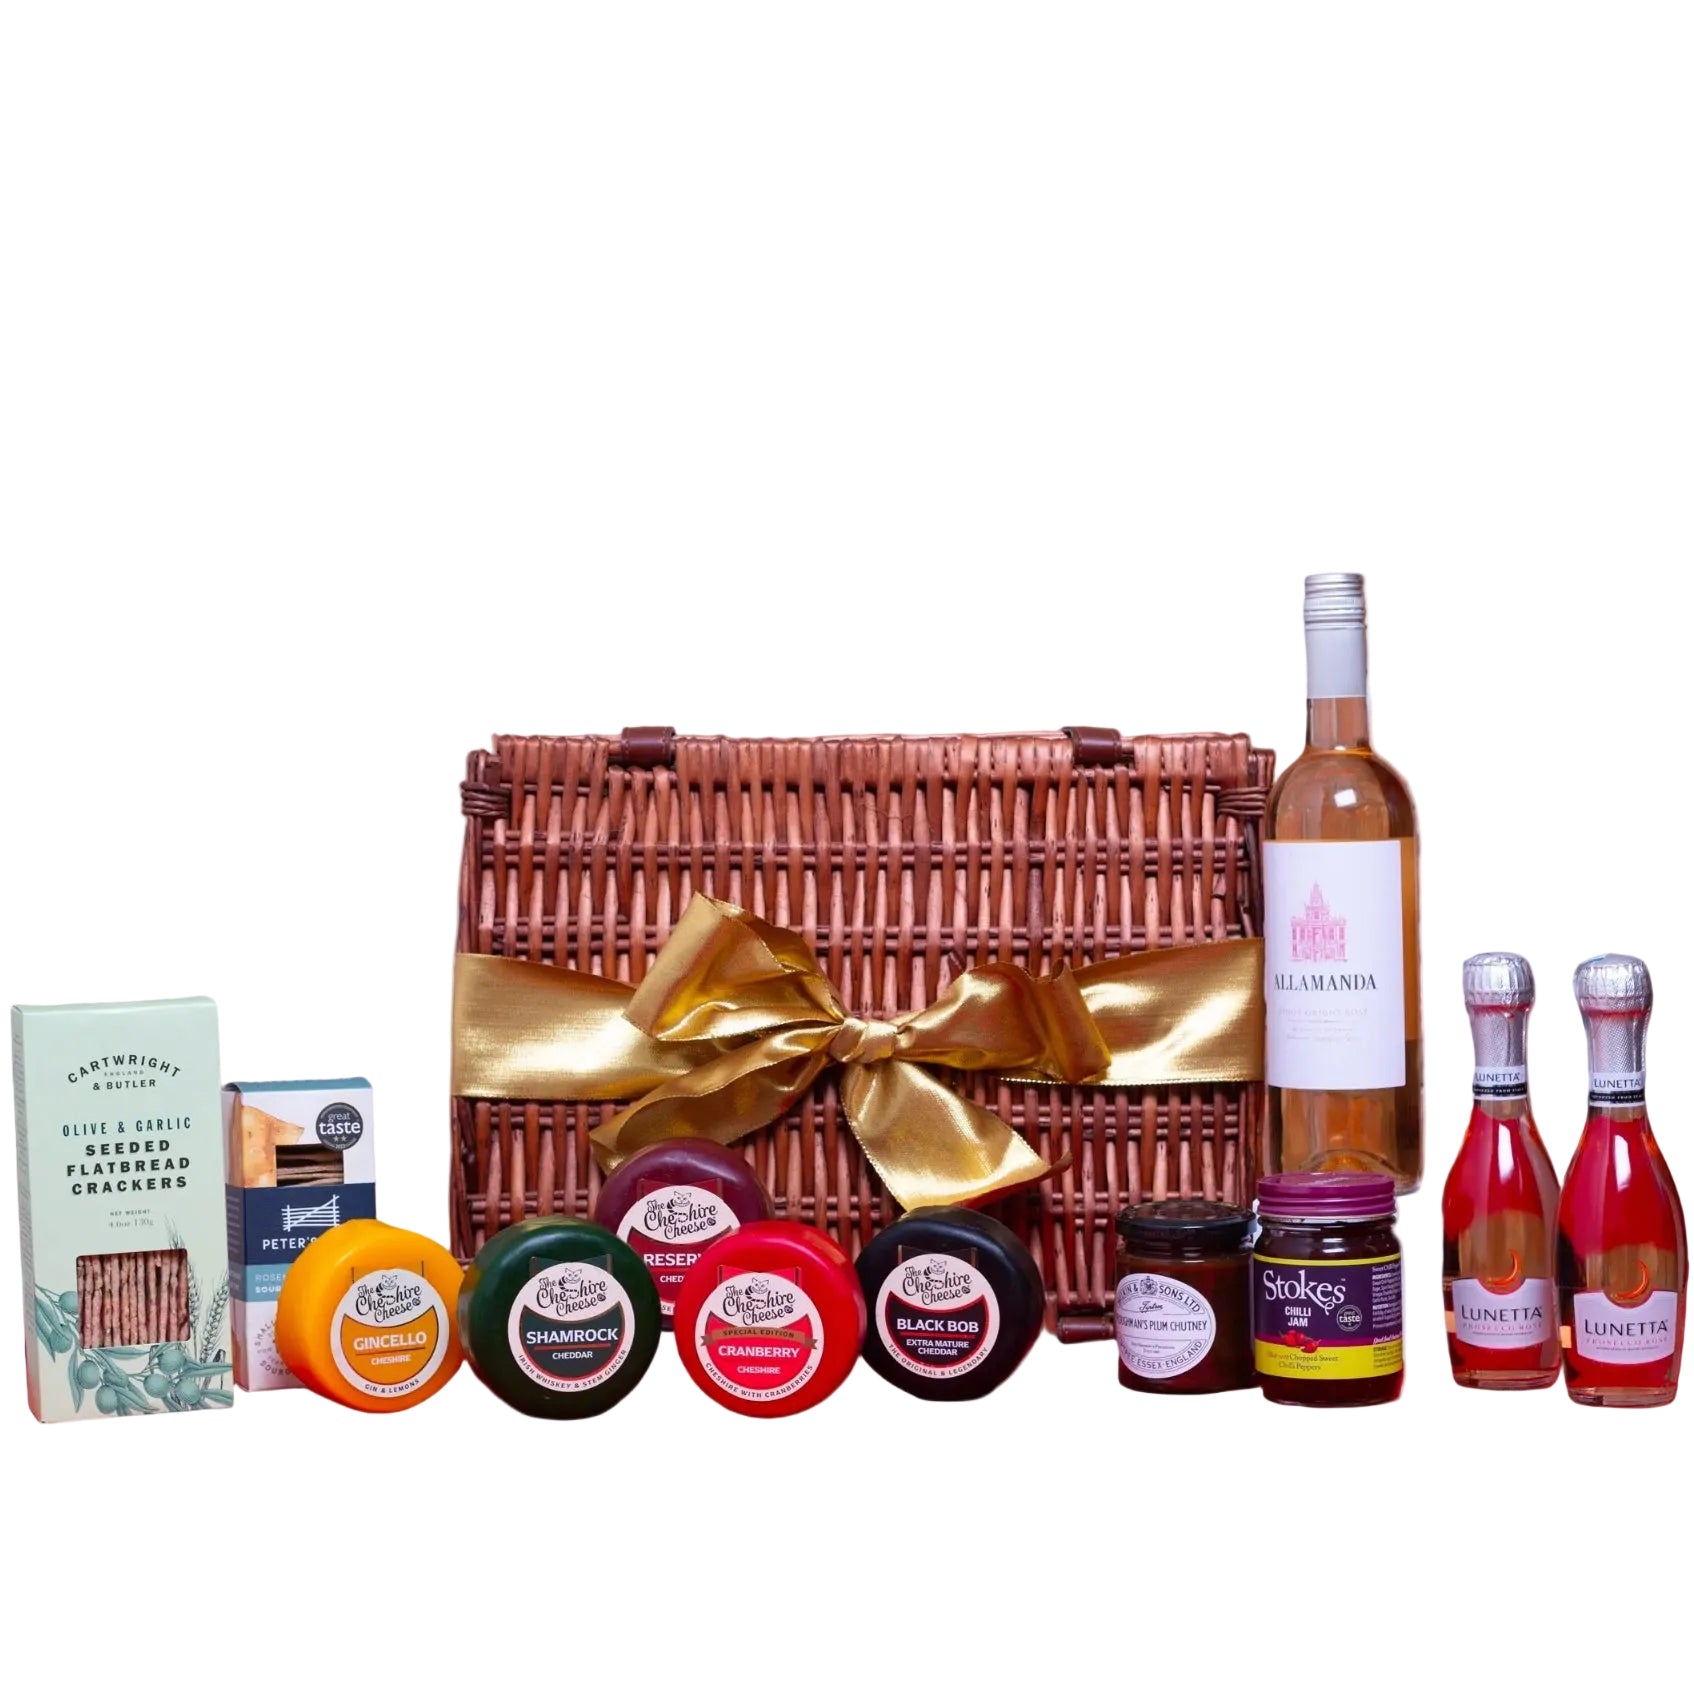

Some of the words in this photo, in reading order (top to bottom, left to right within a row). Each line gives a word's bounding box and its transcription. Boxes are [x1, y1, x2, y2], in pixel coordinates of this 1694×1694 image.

[1274, 973, 1378, 991] ALLAMANDA
[68, 1054, 181, 1084] CARTWRIGHT
[1475, 1072, 1519, 1082] LUNETTA
[1594, 1079, 1641, 1088] LUNETTA
[92, 1082, 101, 1091] &
[106, 1079, 156, 1090] BUTLER
[328, 1112, 351, 1123] great
[62, 1122, 107, 1137] OLIVE
[117, 1121, 125, 1133] &
[136, 1117, 191, 1132] GARLIC
[318, 1121, 361, 1135] taste
[85, 1139, 170, 1156] SEEDED
[66, 1157, 190, 1177] FLATBREAD
[71, 1176, 187, 1195] CRACKERS
[647, 1200, 665, 1212] The
[664, 1219, 707, 1240] Cheese
[643, 1253, 701, 1266] RESER
[905, 1266, 922, 1279] The
[539, 1276, 557, 1290] The
[358, 1284, 374, 1299] The
[725, 1286, 743, 1298] The
[921, 1286, 962, 1305] Cheese
[1263, 1269, 1346, 1315] Stokes
[556, 1296, 598, 1316] Cheese
[1159, 1285, 1184, 1301] SONS
[1184, 1296, 1200, 1313] LTD
[374, 1302, 411, 1323] Cheese
[742, 1307, 785, 1326] Cheese
[1285, 1306, 1311, 1316] CHILLI
[1461, 1304, 1542, 1322] LUNETTA
[897, 1319, 945, 1331] BLACK
[948, 1321, 979, 1333] BOB
[1150, 1320, 1168, 1331] PLUM
[1170, 1320, 1207, 1331] CHUTNEY
[1288, 1317, 1308, 1327] JAM
[1339, 1315, 1361, 1323] taste
[760, 1329, 795, 1338] EDITION
[1585, 1319, 1668, 1336] LUNETTA
[354, 1331, 427, 1351] GINCELLO
[526, 1328, 619, 1344] SHAMROCK
[906, 1339, 934, 1347] EXTRA
[935, 1340, 969, 1349] MATURE
[552, 1351, 593, 1359] CHEDDAR
[718, 1345, 800, 1358] CRANBERRY
[918, 1347, 958, 1356] CHEDDAR
[1137, 1358, 1163, 1369] ESSEX
[1166, 1341, 1203, 1368] ENGLAND
[1319, 1354, 1339, 1362] Sweet
[371, 1354, 412, 1366] CHESHIRE
[889, 1344, 900, 1358] THE
[901, 1358, 937, 1376] ORIGINAL
[948, 1347, 988, 1376] LEGENDARY
[1296, 1363, 1321, 1371] Peppers
[519, 1354, 534, 1374] IRISH
[536, 1373, 570, 1389] WHISKEY
[583, 1376, 602, 1387] STEM
[605, 1350, 627, 1376] GINGER
[737, 1366, 780, 1374] CHESHIRE
[365, 1384, 378, 1392] GIN
[389, 1380, 419, 1393] LEMONS
[706, 1362, 738, 1393] CHESHIRE
[741, 1390, 762, 1398] WITH
[765, 1365, 813, 1398] CRANBERRIES
